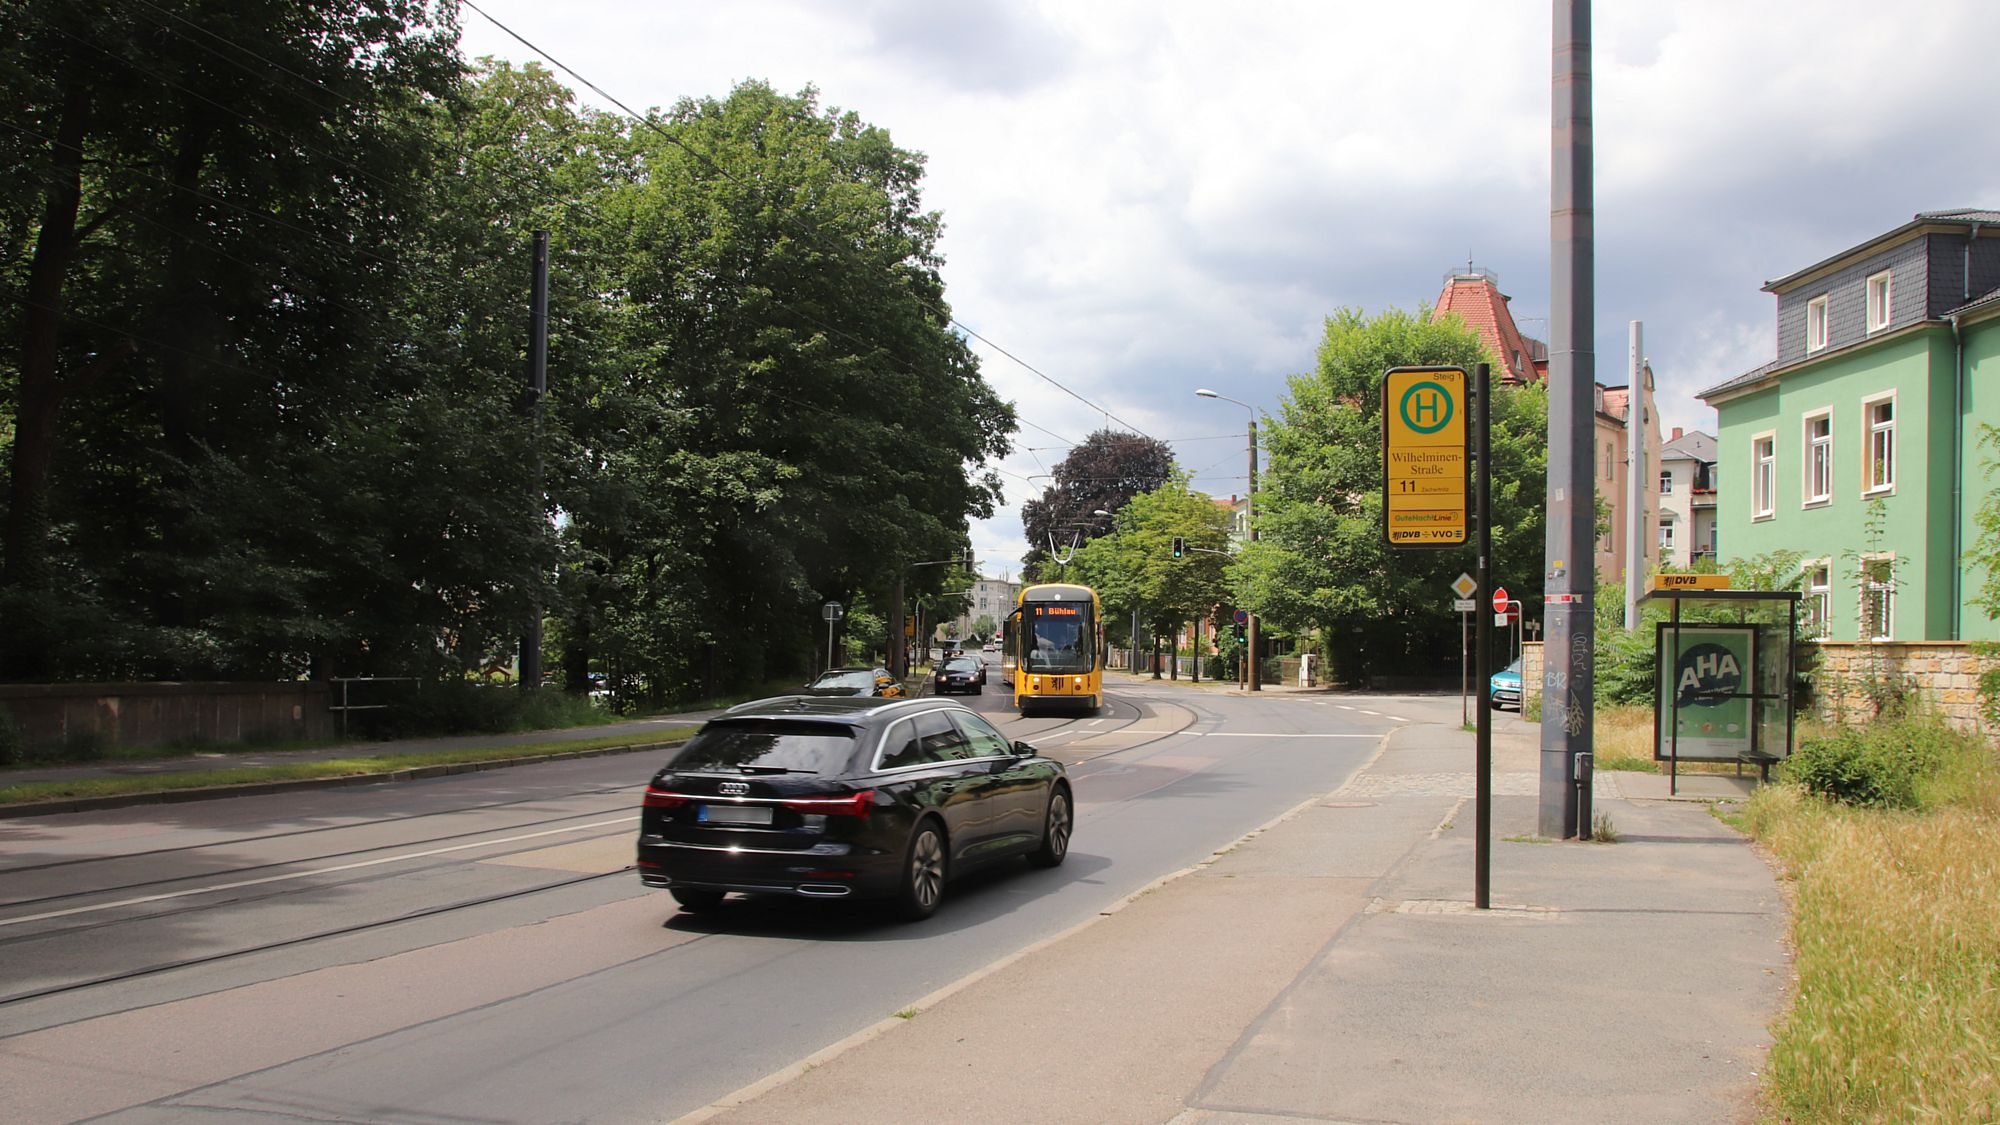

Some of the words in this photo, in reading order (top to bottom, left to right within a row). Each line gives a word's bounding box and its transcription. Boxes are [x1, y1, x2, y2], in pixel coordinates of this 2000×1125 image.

[1433, 373, 1454, 381] Steig
[1416, 393, 1437, 422] H
[1392, 452, 1462, 462] Wilhelminen-
[1410, 465, 1443, 475] Straße
[1400, 480, 1416, 492] 11
[1431, 530, 1453, 538] VVO
[1675, 576, 1697, 584] DVB
[1035, 607, 1042, 615] 11
[1048, 607, 1076, 615] Bühlau
[1678, 653, 1740, 691] AHA
